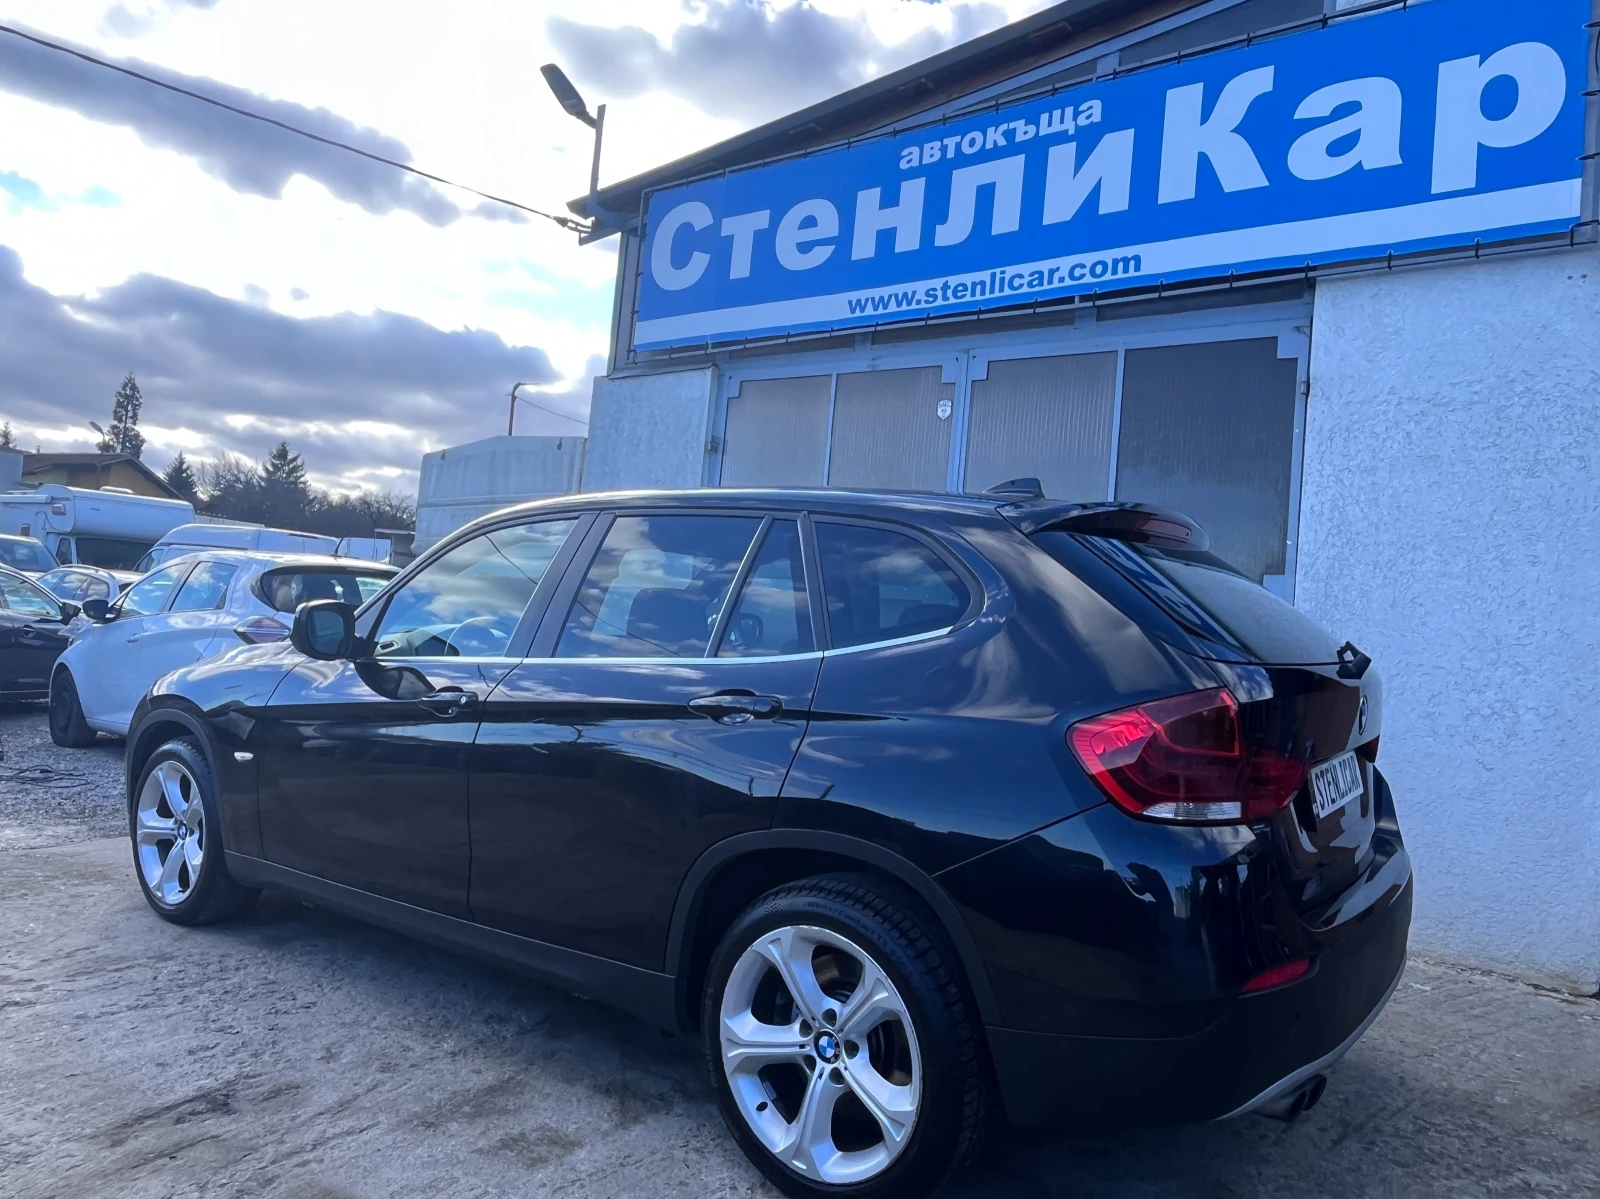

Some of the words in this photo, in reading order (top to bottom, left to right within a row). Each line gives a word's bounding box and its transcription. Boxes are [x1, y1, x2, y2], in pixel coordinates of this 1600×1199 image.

[651, 41, 1567, 291] СтенлиКар
[899, 98, 1103, 170] автокъща
[847, 252, 1143, 315] www.stenlicar.com
